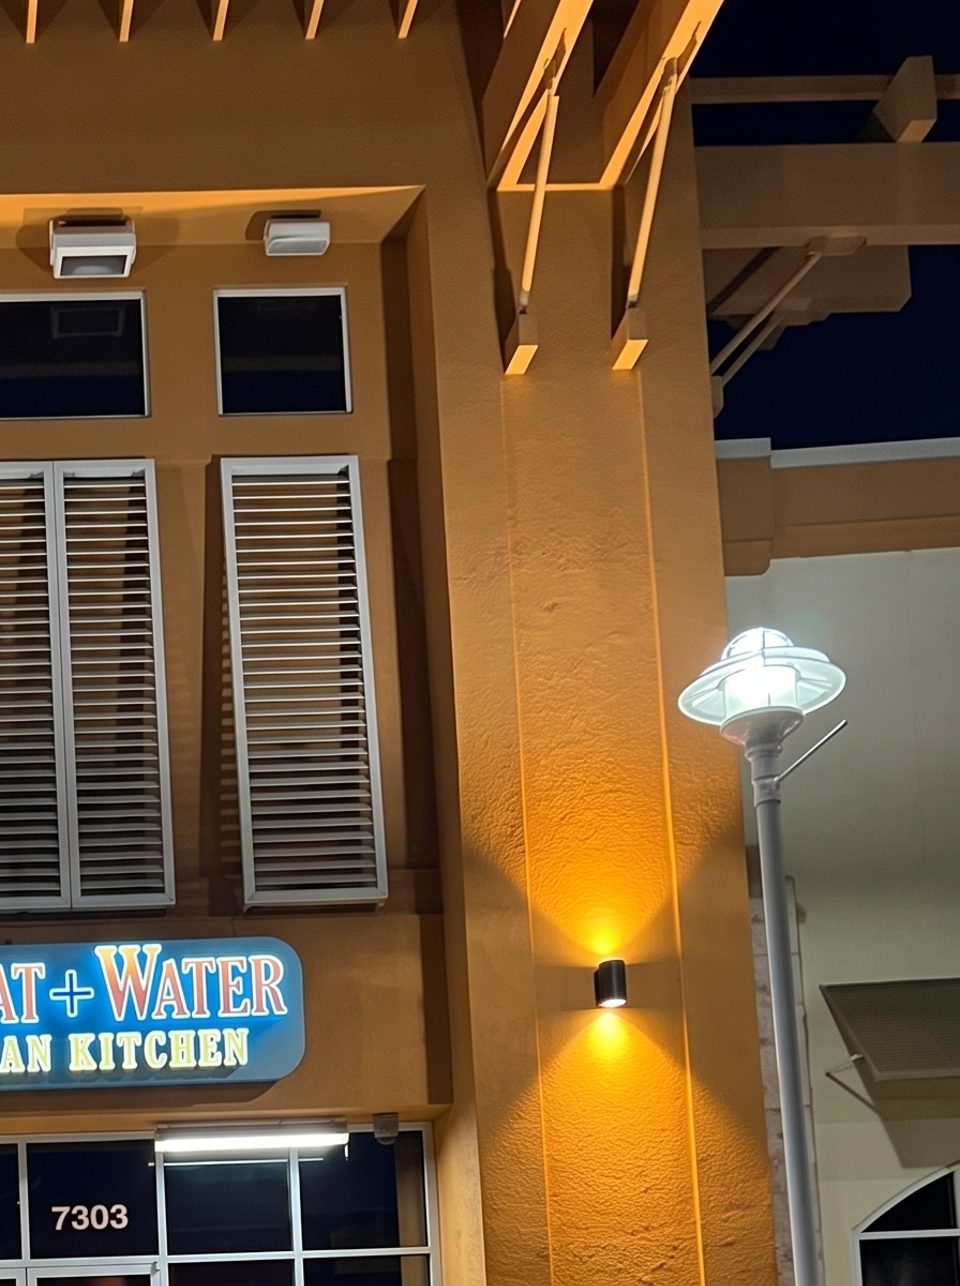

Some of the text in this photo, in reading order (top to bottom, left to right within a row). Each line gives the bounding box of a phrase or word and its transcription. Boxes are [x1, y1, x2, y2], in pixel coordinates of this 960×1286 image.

[95, 944, 287, 1021] WATER
[70, 1029, 249, 1072] KITCHEN
[51, 1204, 129, 1231] 7303
